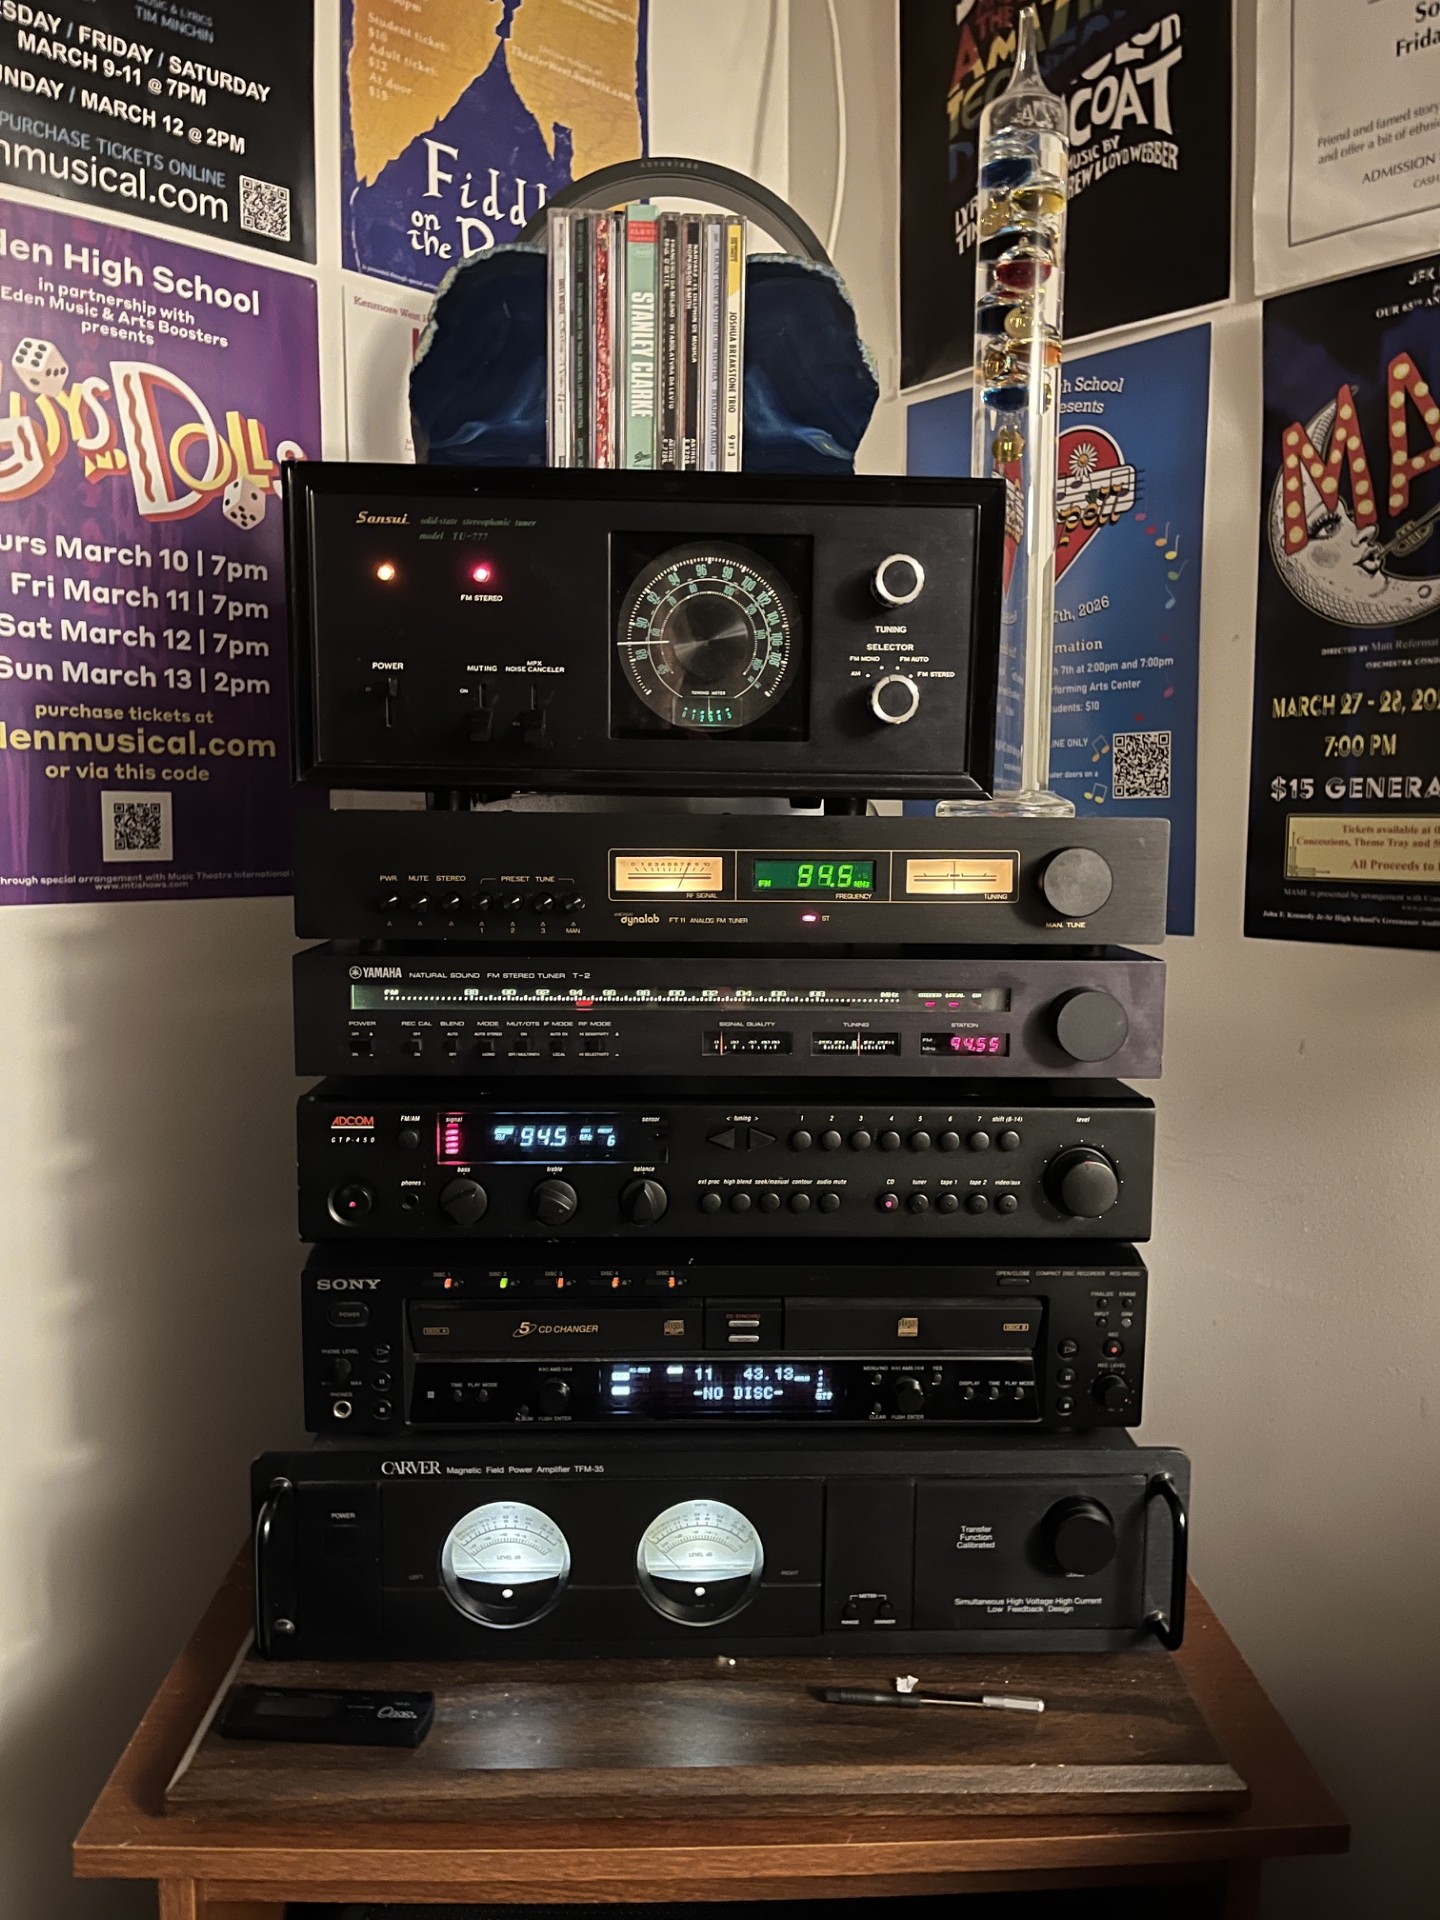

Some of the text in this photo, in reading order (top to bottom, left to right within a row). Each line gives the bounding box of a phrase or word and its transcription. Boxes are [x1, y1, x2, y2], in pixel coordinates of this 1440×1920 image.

[161, 16, 214, 44] MINCHIN
[17, 29, 207, 106] MARCH 9-11 @ 7PM
[78, 25, 271, 103] FRIDAY SATURDAY
[1069, 45, 1182, 147] COAT
[80, 89, 245, 155] MARCH 12 @ 2PM
[1352, 120, 1374, 137] and
[0, 111, 226, 188] PURCHASE TICKETS ONLINE
[1102, 135, 1120, 153] BY
[1094, 141, 1179, 181] LLOYD WEBBER
[1362, 152, 1437, 184] ADMISSION
[411, 211, 441, 232] on
[64, 244, 143, 288] High
[153, 266, 260, 316] School
[38, 277, 195, 325] in partnership with
[1, 286, 228, 347] Eden Music & Arts Boosters
[81, 320, 155, 345] presents
[631, 291, 655, 418] STANLEY CLARKE
[728, 312, 738, 413] JOSHUA BREAKSTONE TRIO
[1074, 376, 1124, 394] School
[356, 511, 411, 525] Sansui
[55, 535, 151, 568] March
[159, 549, 189, 572] 10
[211, 555, 268, 582] 7pm
[695, 564, 707, 577] 96
[721, 565, 734, 580] 98
[741, 576, 757, 592] 100
[11, 572, 269, 621] Fri March 11 7pm
[474, 594, 503, 602] STEREO
[755, 591, 772, 607] 102
[1078, 596, 1109, 619] 2026
[766, 611, 781, 626] 104
[0, 613, 269, 659] Sat March 12 7pm
[875, 625, 907, 634] TUNING
[635, 648, 648, 661] 88
[866, 643, 915, 651] SELECTOR
[372, 662, 404, 671] POWER
[1087, 656, 1174, 674] 2:00pm and 7:00pm
[0, 656, 270, 697] Sun March 13 2pm
[1089, 679, 1141, 692] Arts Center
[1085, 700, 1100, 711] $10
[1272, 692, 1363, 718] MARCH 27
[35, 703, 214, 724] purchase tickets at
[1067, 738, 1088, 747] ONLY
[1324, 734, 1397, 758] 7:00 PM
[45, 762, 209, 781] or via this code
[1270, 776, 1315, 801] $15
[1342, 824, 1418, 835] Tickets available
[1371, 860, 1419, 871] Proceeds
[41, 873, 142, 886] special arrangement
[500, 875, 530, 883] PRESET
[621, 913, 660, 926] dynalab
[363, 967, 402, 979] YAMAHA
[331, 1116, 375, 1126] ADCOM
[400, 1115, 421, 1123] FM/AM
[520, 1126, 567, 1147] 94.5
[633, 1165, 656, 1173] balance
[401, 1180, 422, 1188] phones
[317, 1278, 382, 1291] SONY
[553, 1324, 599, 1333] CHANGER
[381, 1461, 604, 1475] CARVER Magnetic Field Power Amplifier TFM-35
[957, 1541, 996, 1549] Calibrated
[960, 1533, 993, 1541] Function
[955, 1598, 1054, 1606] Simultaneous Voltage
[1047, 1606, 1074, 1614] Design
